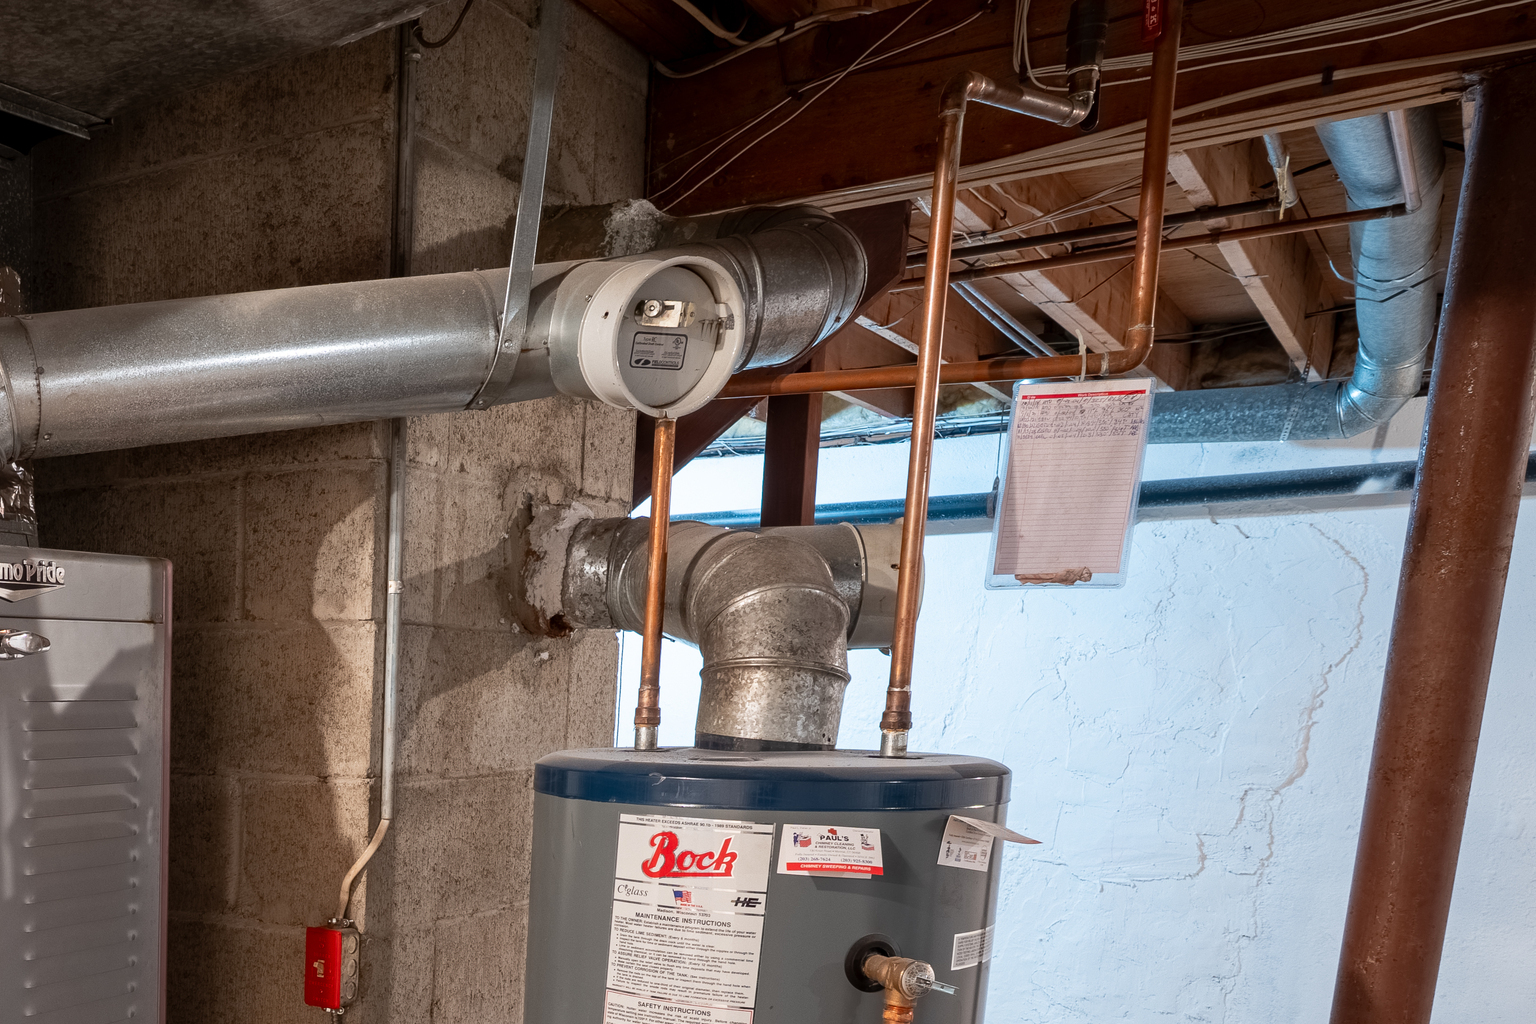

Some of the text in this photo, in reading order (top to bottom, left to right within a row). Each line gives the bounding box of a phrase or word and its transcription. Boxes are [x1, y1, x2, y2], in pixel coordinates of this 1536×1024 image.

[23, 559, 65, 584] Pride
[642, 831, 737, 878] Bock
[635, 912, 731, 927] MAINTENANCE INSTRUCTIONS
[638, 1001, 711, 1016] SAFETY INSTRUCTIONS
